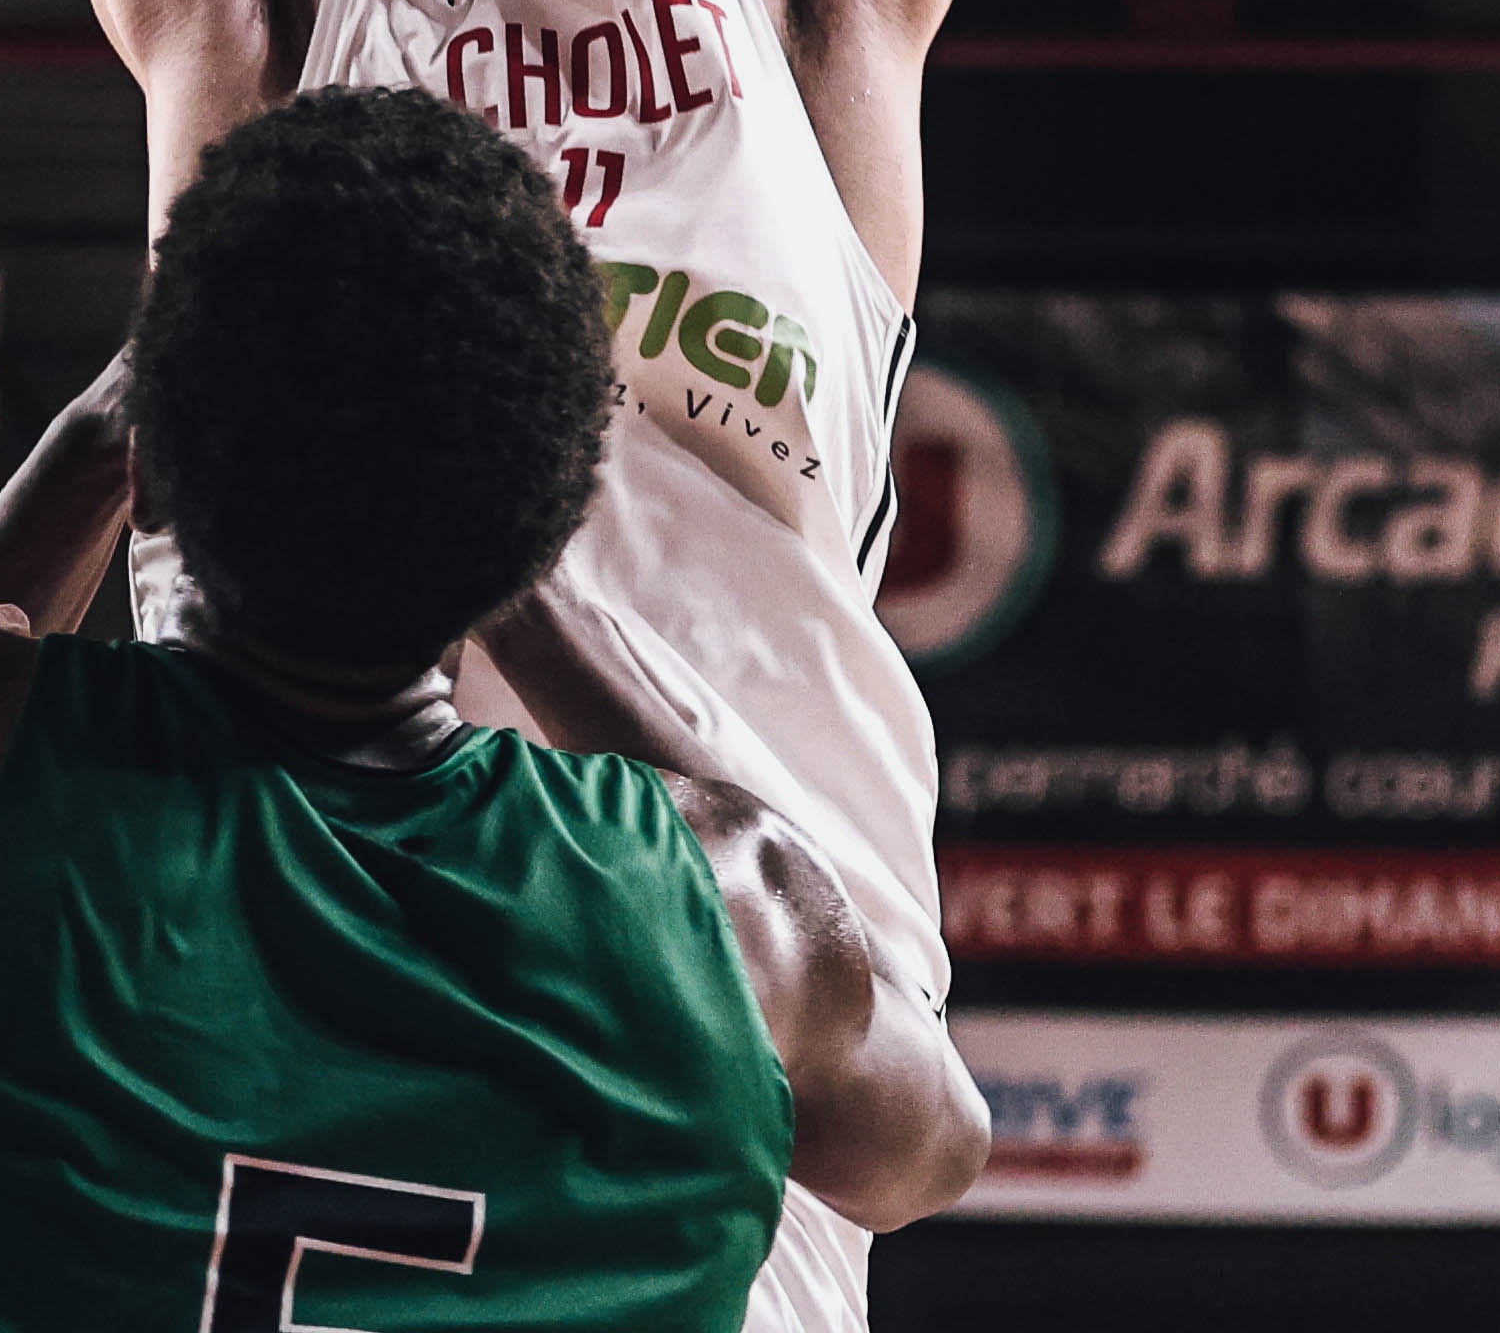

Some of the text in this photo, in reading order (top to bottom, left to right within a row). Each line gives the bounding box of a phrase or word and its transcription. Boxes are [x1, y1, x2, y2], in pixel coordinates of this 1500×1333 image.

[560, 148, 626, 229] 11
[686, 388, 821, 481] Vivez
[1144, 871, 1236, 949] LE
